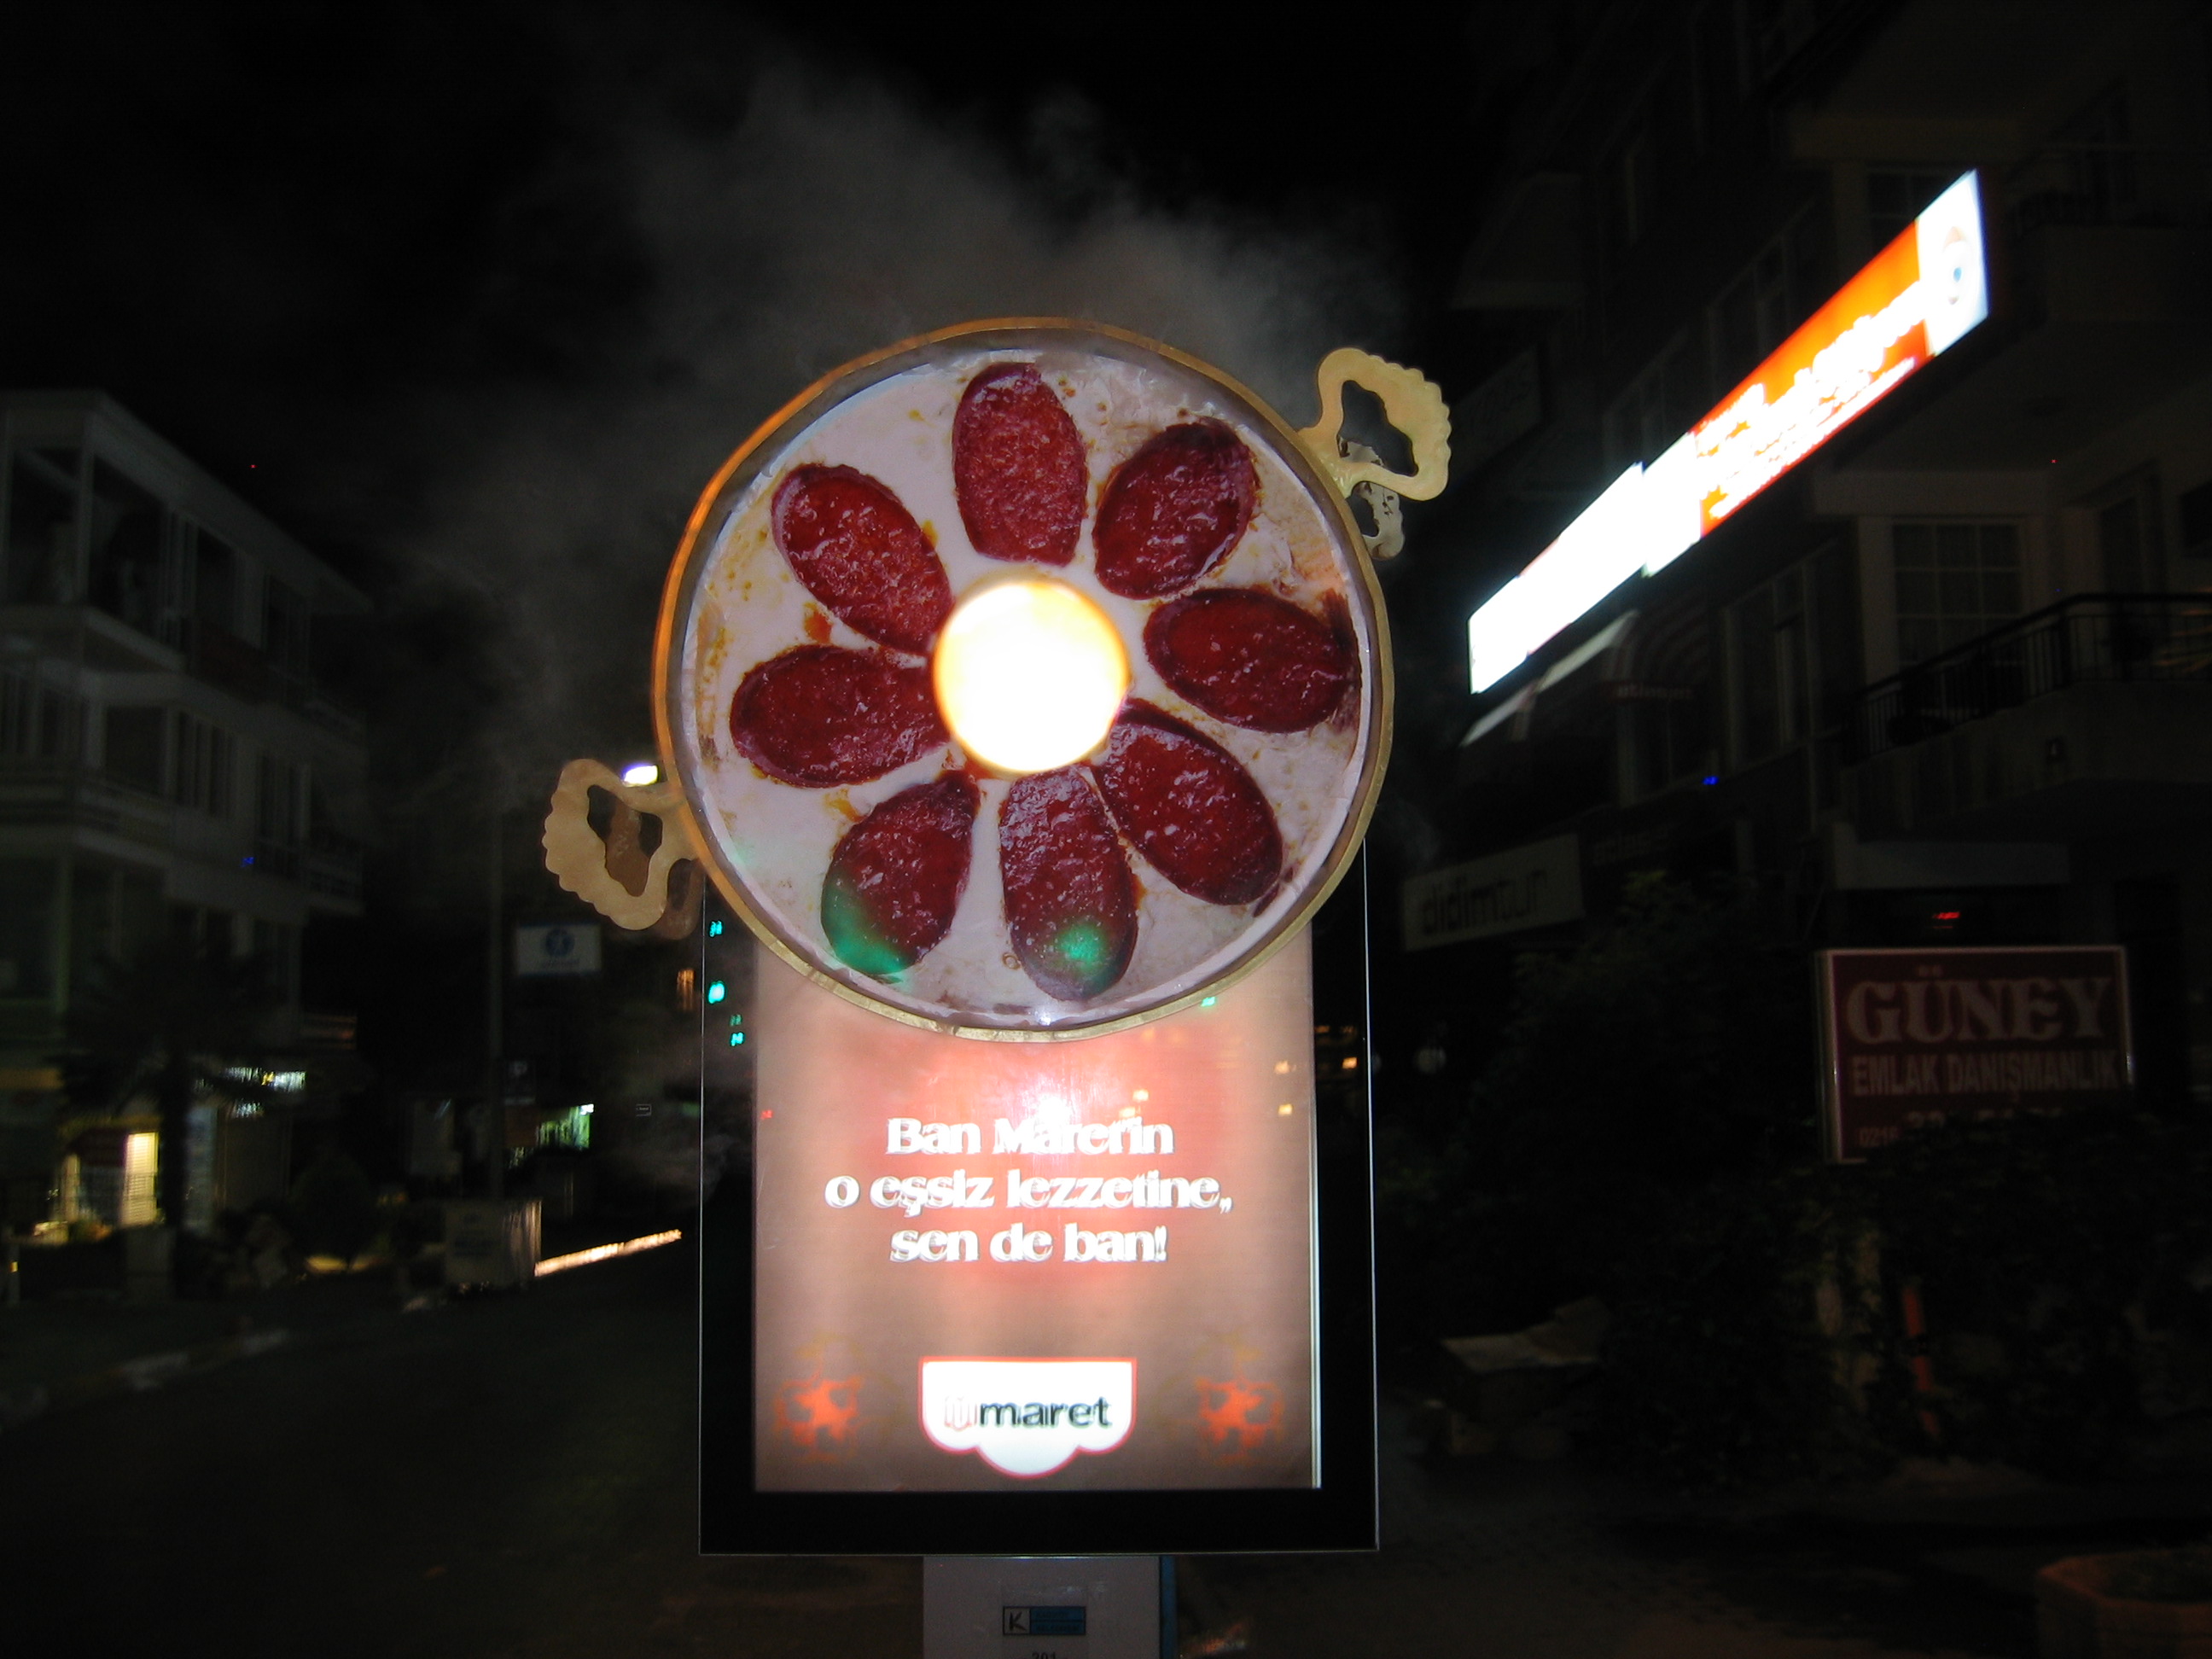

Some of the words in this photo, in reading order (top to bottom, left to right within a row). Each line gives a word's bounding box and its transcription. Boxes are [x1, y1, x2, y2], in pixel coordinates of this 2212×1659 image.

[1845, 964, 2112, 1045] GÜNEY
[1851, 1053, 1940, 1096] EMLAK
[1946, 1050, 2120, 1102] DANIŞMANLIK
[885, 1117, 982, 1155] Ban
[824, 1174, 861, 1208] o
[869, 1168, 995, 1218] eşsiz
[1006, 1168, 1234, 1214] lezzetine,
[889, 1230, 981, 1262] sen
[989, 1221, 1054, 1262] de
[1063, 1221, 1168, 1262] ban!
[980, 1395, 1112, 1429] maret
